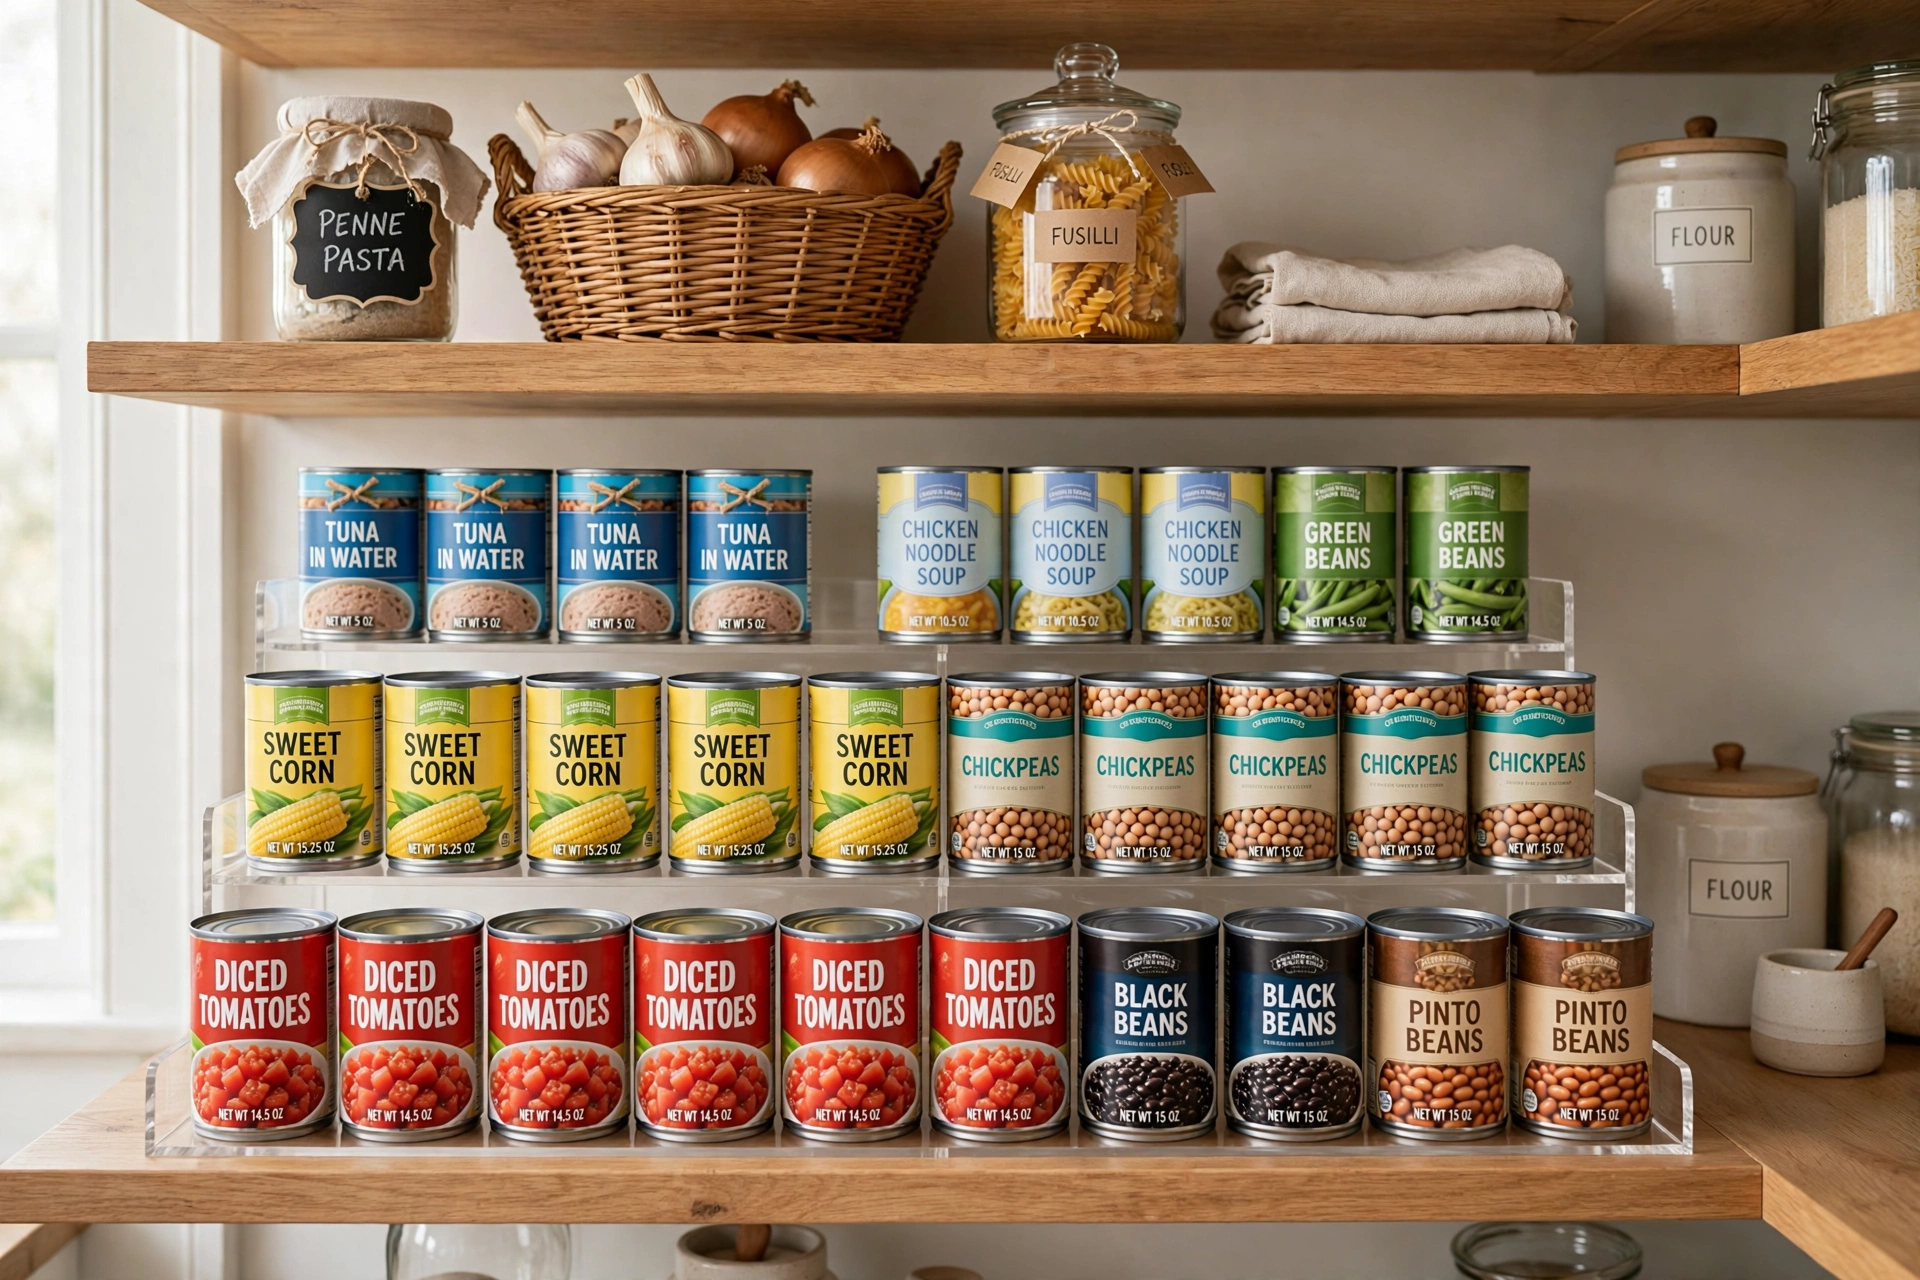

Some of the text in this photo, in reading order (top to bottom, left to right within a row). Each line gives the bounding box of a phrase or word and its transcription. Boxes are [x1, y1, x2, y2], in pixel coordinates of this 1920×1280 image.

[319, 209, 405, 238] PENNE
[1052, 227, 1118, 245] FUSILLI
[1672, 225, 1735, 247] FLOUR
[324, 245, 405, 273] PASTA
[325, 521, 379, 542] TUNA
[453, 522, 507, 544] TUNA
[587, 523, 641, 545] TUNA
[717, 523, 771, 545] TUNA
[902, 520, 978, 539] CHICKEN
[1032, 520, 1108, 539] CHICKEN
[1165, 520, 1241, 539] CHICKEN
[1304, 521, 1370, 544] GREEN
[1438, 521, 1504, 544] GREEN
[310, 546, 397, 568] IN WATER
[438, 548, 525, 570] IN WATER
[571, 549, 658, 570] IN WATER
[701, 549, 788, 570] IN WATER
[906, 543, 976, 563] NOODLE
[1035, 543, 1106, 563] NOODLE
[1168, 543, 1239, 563] NOODLE
[1304, 546, 1370, 569] BEANS
[1438, 546, 1504, 569] BEANS
[918, 566, 966, 586] SOUP
[1047, 566, 1095, 586] SOUP
[1180, 566, 1229, 586] SOUP
[326, 616, 373, 626] NET WT 5 OZ
[719, 618, 765, 629] NET WT 5 OZ
[909, 616, 969, 627] NET WT 10.5 OZ
[1306, 616, 1366, 627] NET WT 14.5 OZ
[263, 731, 341, 756] SWEET
[403, 732, 481, 758] SWEET
[549, 733, 627, 758] SWEET
[693, 733, 771, 758] SWEET
[836, 733, 914, 758] SWEET
[269, 759, 334, 784] CORN
[410, 760, 475, 785] CORN
[962, 755, 1060, 777] CHICKPEAS
[1096, 755, 1194, 777] CHICKPEAS
[1229, 754, 1327, 776] CHICKPEAS
[1360, 752, 1457, 776] CHICKPEAS
[1488, 750, 1586, 774] CHICKPEAS
[556, 761, 621, 786] CORN
[699, 761, 765, 786] CORN
[843, 761, 908, 786] CORN
[267, 841, 334, 854] NET WT 15.25 OZ
[408, 843, 475, 855] NET WT 15.25 OZ
[697, 844, 765, 856] NET WT 15.25 OZ
[841, 844, 908, 856] NET WT 15.25 OZ
[982, 847, 1035, 858] NET WT 15 OZ
[1116, 847, 1171, 858] NET WT 15 OZ
[1381, 845, 1435, 856] NET WT 15 OZ
[1509, 843, 1564, 854] NET WT 15 OZ
[1707, 878, 1773, 901] FLOUR
[215, 959, 287, 992] DICED
[364, 959, 436, 992] DICED
[516, 959, 588, 992] DICED
[664, 959, 736, 992] DICED
[812, 959, 884, 992] DICED
[963, 958, 1036, 991] DICED
[1114, 982, 1188, 1008] BLACK
[1263, 982, 1336, 1008] BLACK
[199, 993, 310, 1030] TOMATOES
[348, 993, 459, 1030] TOMATOES
[500, 993, 610, 1030] TOMATOES
[647, 993, 757, 1030] TOMATOES
[795, 993, 905, 1030] TOMATOES
[945, 993, 1056, 1029] TOMATOES
[1409, 999, 1480, 1026] PINTO
[1556, 999, 1626, 1026] PINTO
[1114, 1011, 1189, 1037] BEANS
[1263, 1011, 1337, 1037] BEANS
[1406, 1027, 1483, 1054] BEANS
[1552, 1027, 1629, 1054] BEANS
[219, 1108, 283, 1121] NET WT 14.5 OZ
[368, 1108, 432, 1121] NET WT 14.5 OZ
[520, 1108, 584, 1122] NET WT 14.5 OZ
[816, 1108, 880, 1122] NET WT 14.5 OZ
[967, 1108, 1031, 1122] NET WT 14.5 OZ
[1120, 1109, 1179, 1123] NET WT 15 OZ
[1268, 1109, 1328, 1123] NET WT 15 OZ
[1414, 1108, 1472, 1121] NET WT 15 OZ
[1561, 1108, 1619, 1121] NET WT 15 OZ
